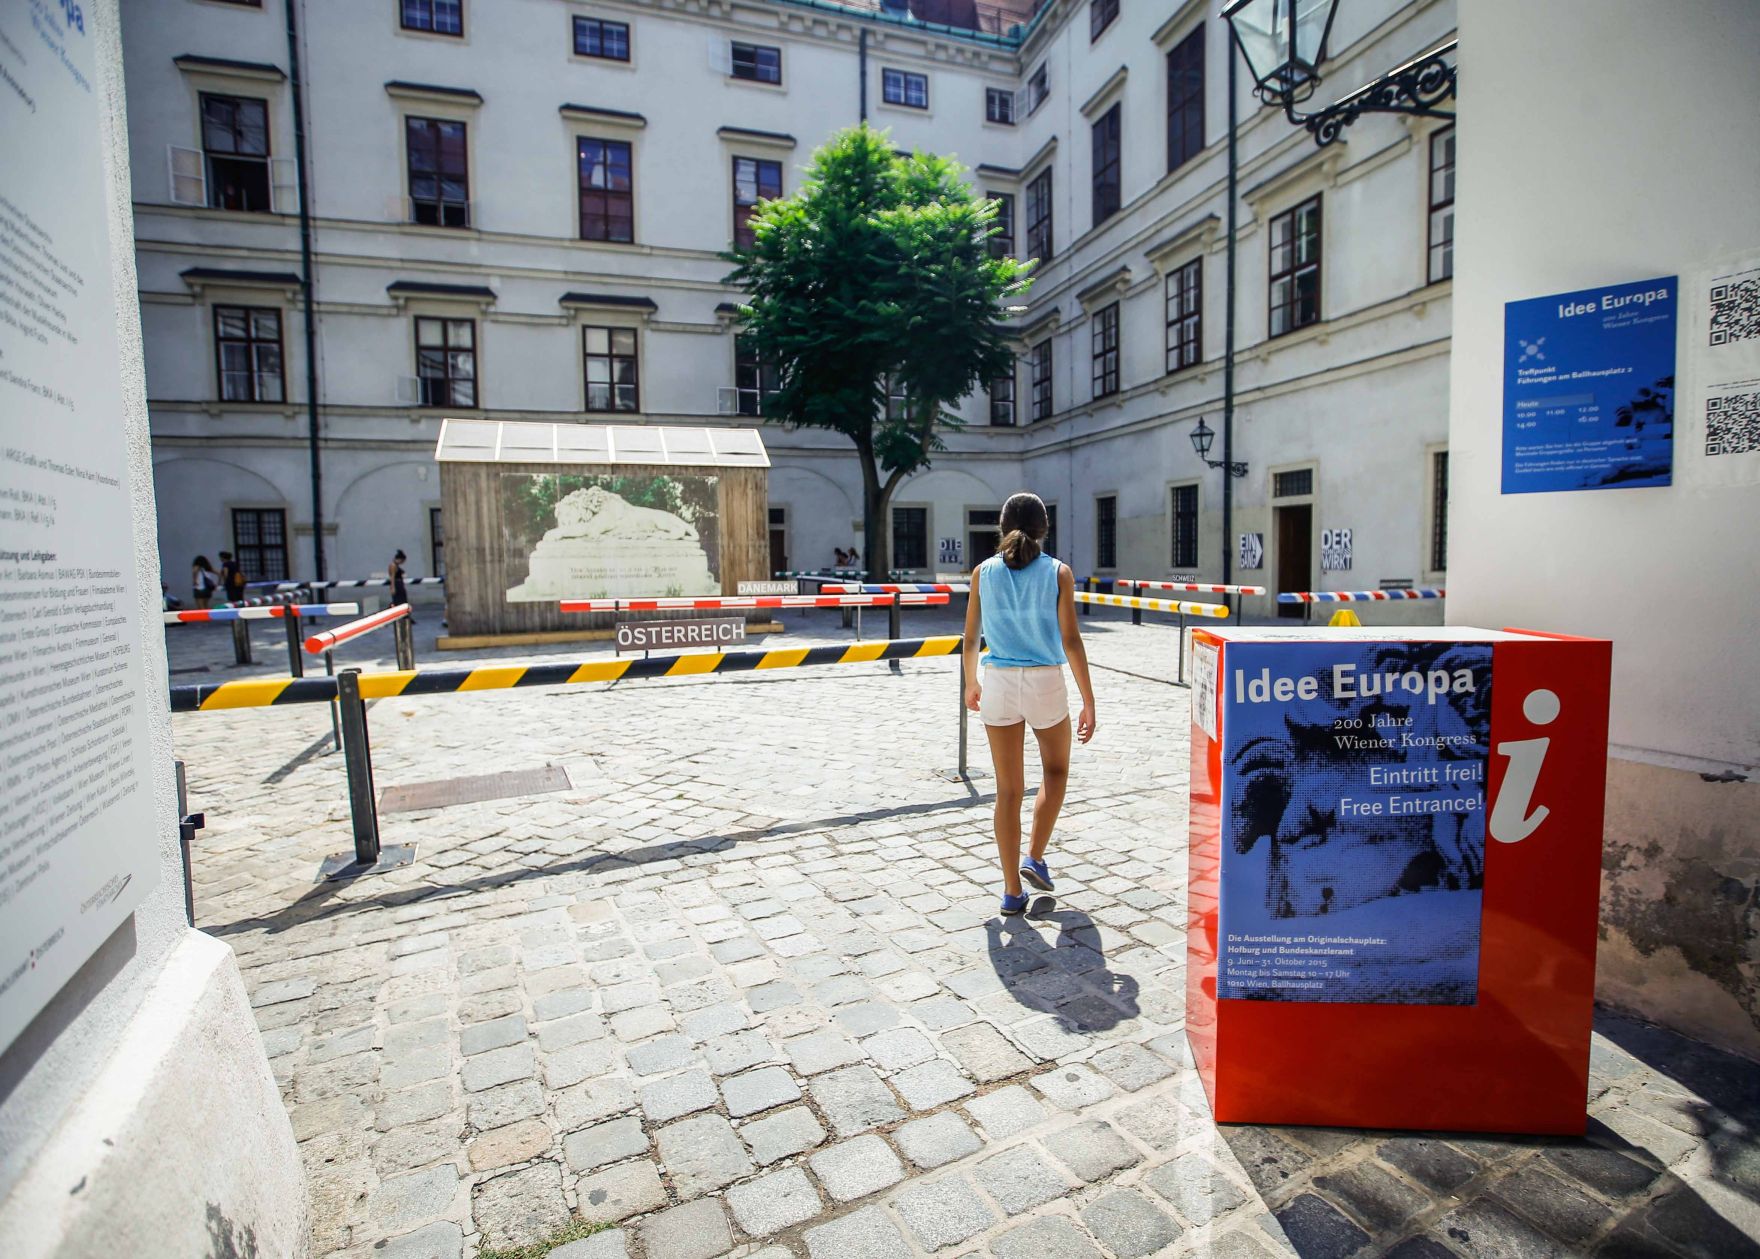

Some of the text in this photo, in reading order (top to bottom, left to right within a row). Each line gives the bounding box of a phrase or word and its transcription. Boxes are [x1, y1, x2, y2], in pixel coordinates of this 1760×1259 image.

[1558, 288, 1669, 319] Idee Europa
[1240, 533, 1257, 551] EIN
[1321, 528, 1352, 550] DER
[1322, 554, 1352, 570] WIRKT
[617, 623, 745, 647] ÖSTERREICH
[1235, 668, 1318, 704] Idee
[1332, 663, 1476, 705] Europa
[1334, 713, 1414, 730] 200 Jahre
[1334, 733, 1477, 751] Wiener Kongress
[1370, 762, 1484, 785] Eintritt frei!
[1340, 793, 1484, 816] Free Entrance!
[1228, 934, 1242, 942] Die
[1243, 935, 1292, 945] Ausstellung
[1307, 935, 1388, 946] Originalschauplatz:
[1227, 946, 1354, 956] Hofburg und Bundeskanzleramt
[1237, 957, 1254, 966] Juni
[1274, 957, 1306, 966] Oktober
[1308, 959, 1328, 968] 2015
[1227, 968, 1258, 978] Montag
[1259, 968, 1271, 977] bis
[1272, 968, 1306, 979] Samstag
[1335, 969, 1350, 978] Uhr
[1271, 980, 1324, 990] Ballhausplatz
